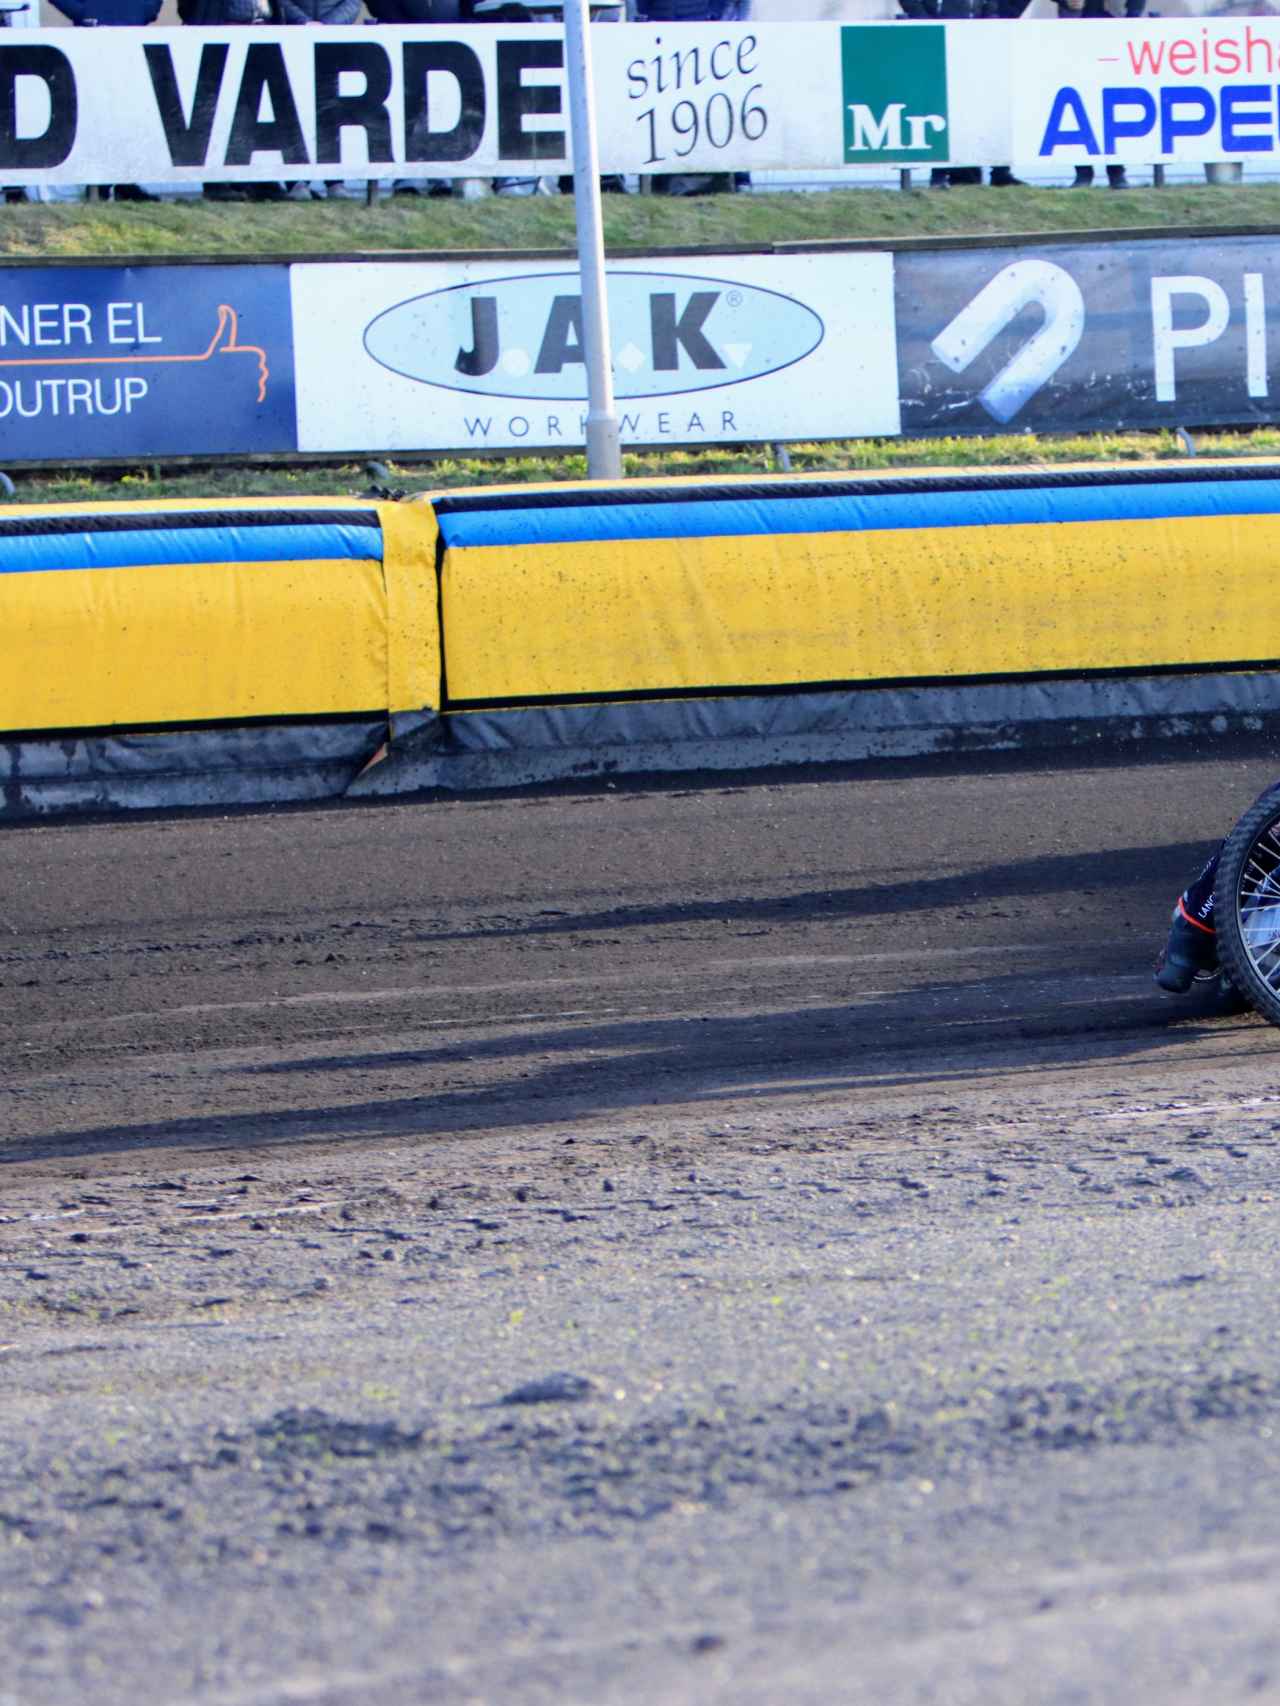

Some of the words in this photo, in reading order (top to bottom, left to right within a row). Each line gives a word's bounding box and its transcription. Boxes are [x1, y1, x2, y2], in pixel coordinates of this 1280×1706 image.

[626, 34, 760, 99] since
[0, 44, 78, 169] D
[142, 40, 567, 167] VARDE
[635, 83, 768, 165] 1906
[847, 103, 946, 150] Mr
[0, 302, 93, 347] NER
[106, 301, 163, 344] EL
